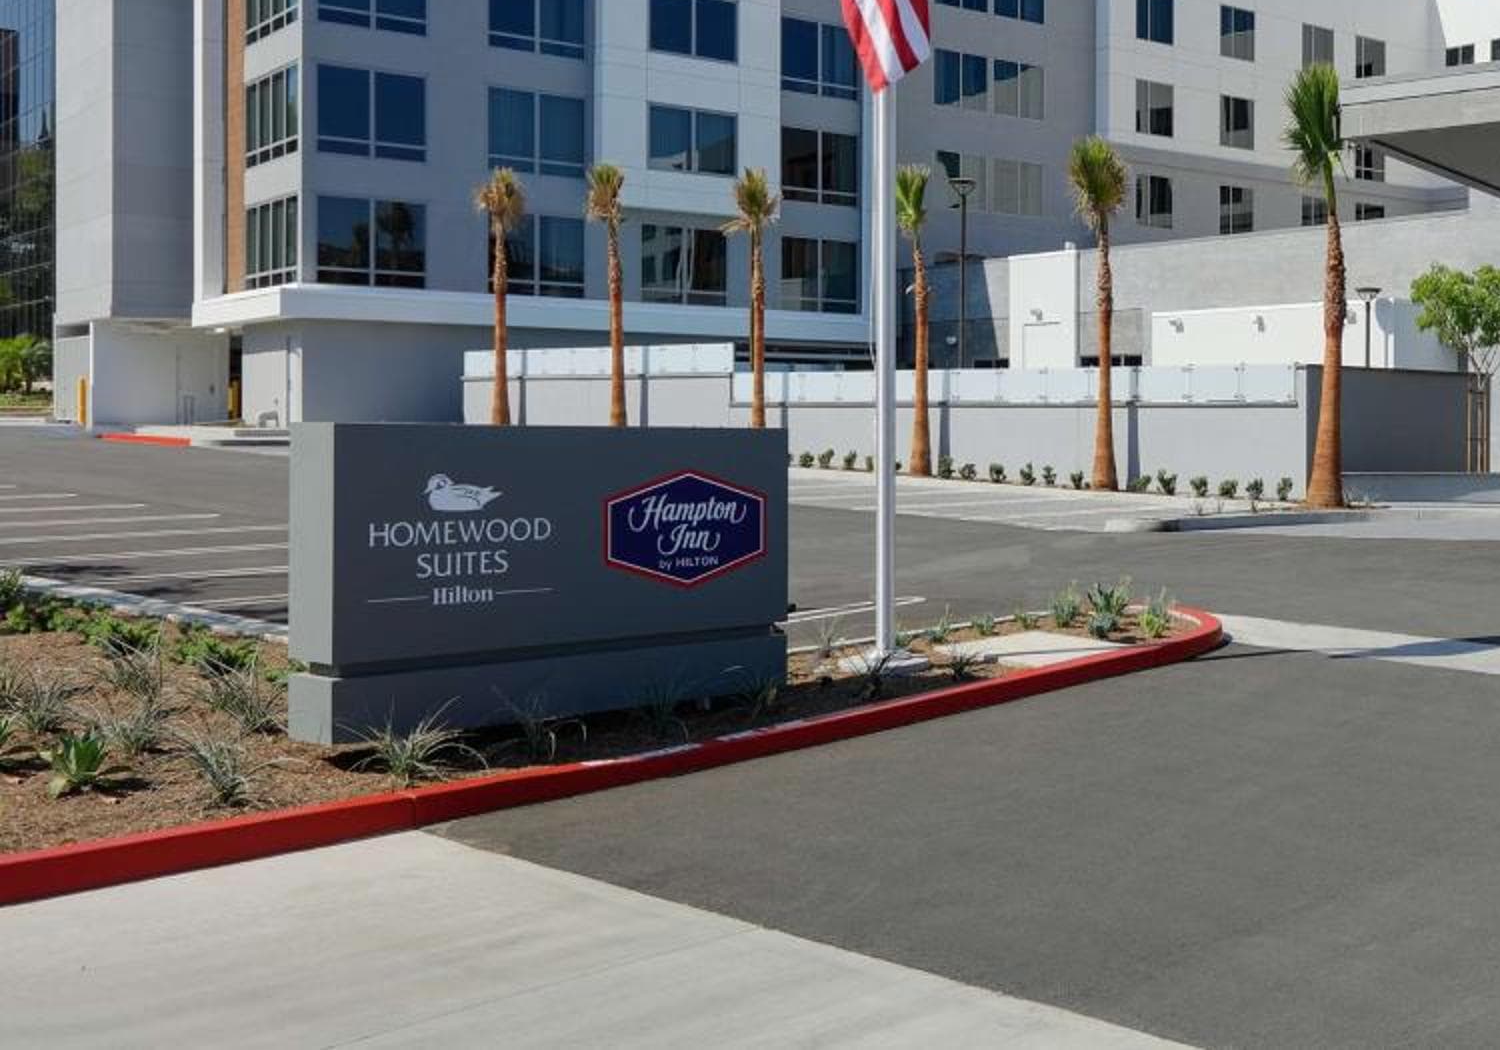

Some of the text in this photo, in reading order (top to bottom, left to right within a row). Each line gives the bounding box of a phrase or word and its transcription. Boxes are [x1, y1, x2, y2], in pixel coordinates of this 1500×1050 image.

[628, 492, 748, 533] Hampton
[368, 517, 552, 548] HOMEWOOD
[657, 523, 721, 555] Inn
[416, 549, 509, 579] SUITES
[658, 556, 719, 571] by HILTON
[433, 585, 494, 605] Hilton
